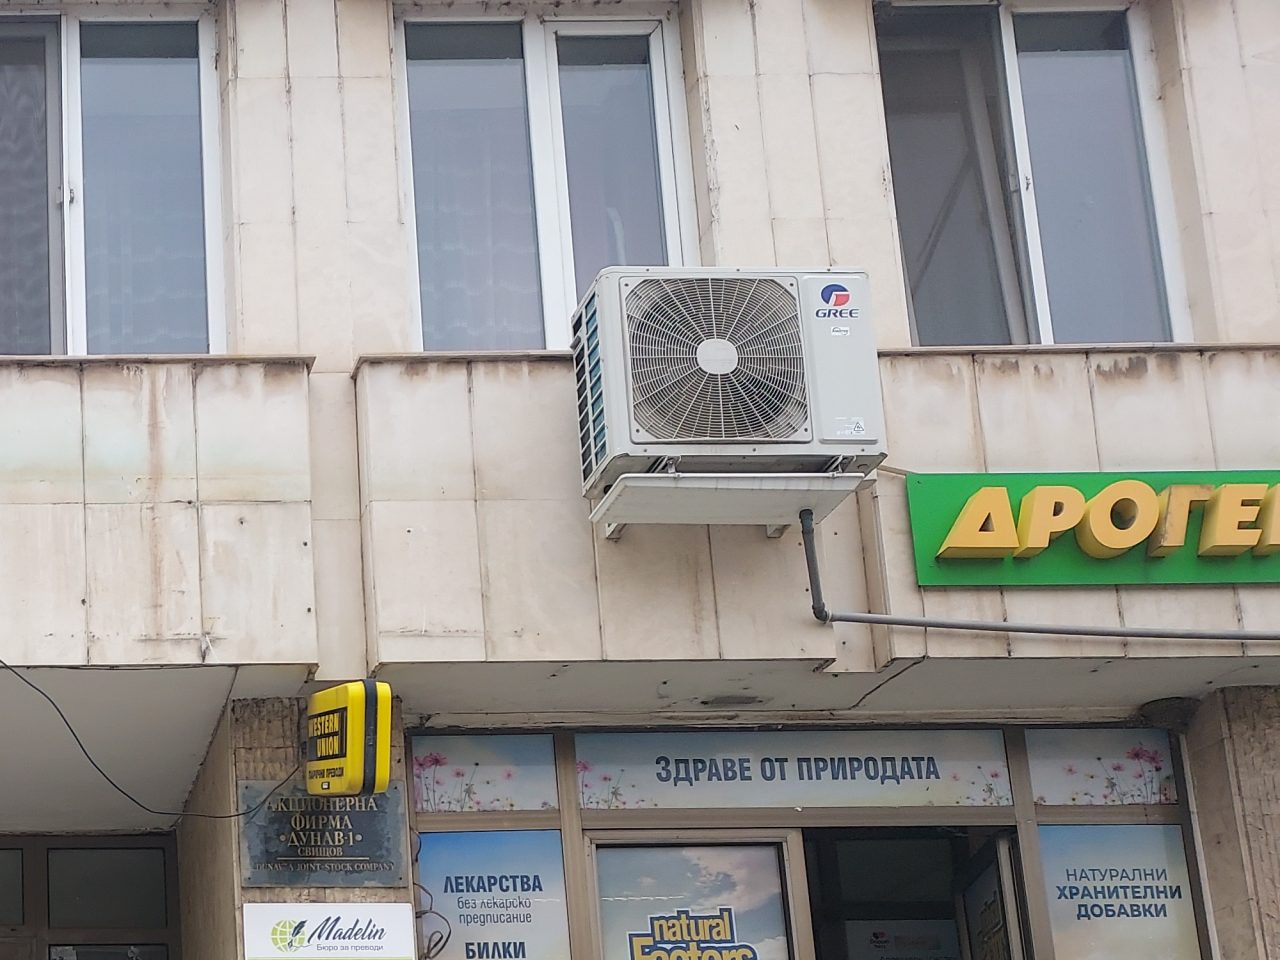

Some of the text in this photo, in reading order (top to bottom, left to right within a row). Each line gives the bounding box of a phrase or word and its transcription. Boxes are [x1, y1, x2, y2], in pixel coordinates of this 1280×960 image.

[815, 308, 859, 318] GREE
[317, 735, 340, 758] UNION
[655, 756, 940, 787] ЗДРАВЕ ОТ ПРИРОДАТА
[290, 813, 353, 831] ФИРМА
[298, 846, 343, 858] СВИЩОВ
[1066, 868, 1168, 882] НАТУРАЛНИ
[444, 875, 543, 894] ЛЕКАРСТВА
[1056, 885, 1183, 900] ХРАНИТЕЛНИ
[457, 895, 532, 911] без лекарско
[1076, 903, 1168, 920] ДОБАВКИ
[459, 912, 532, 927] предписание
[653, 911, 732, 942] natural
[307, 915, 387, 944] Madelin
[316, 943, 338, 951] Бюро
[465, 942, 527, 960] БИЛКИ
